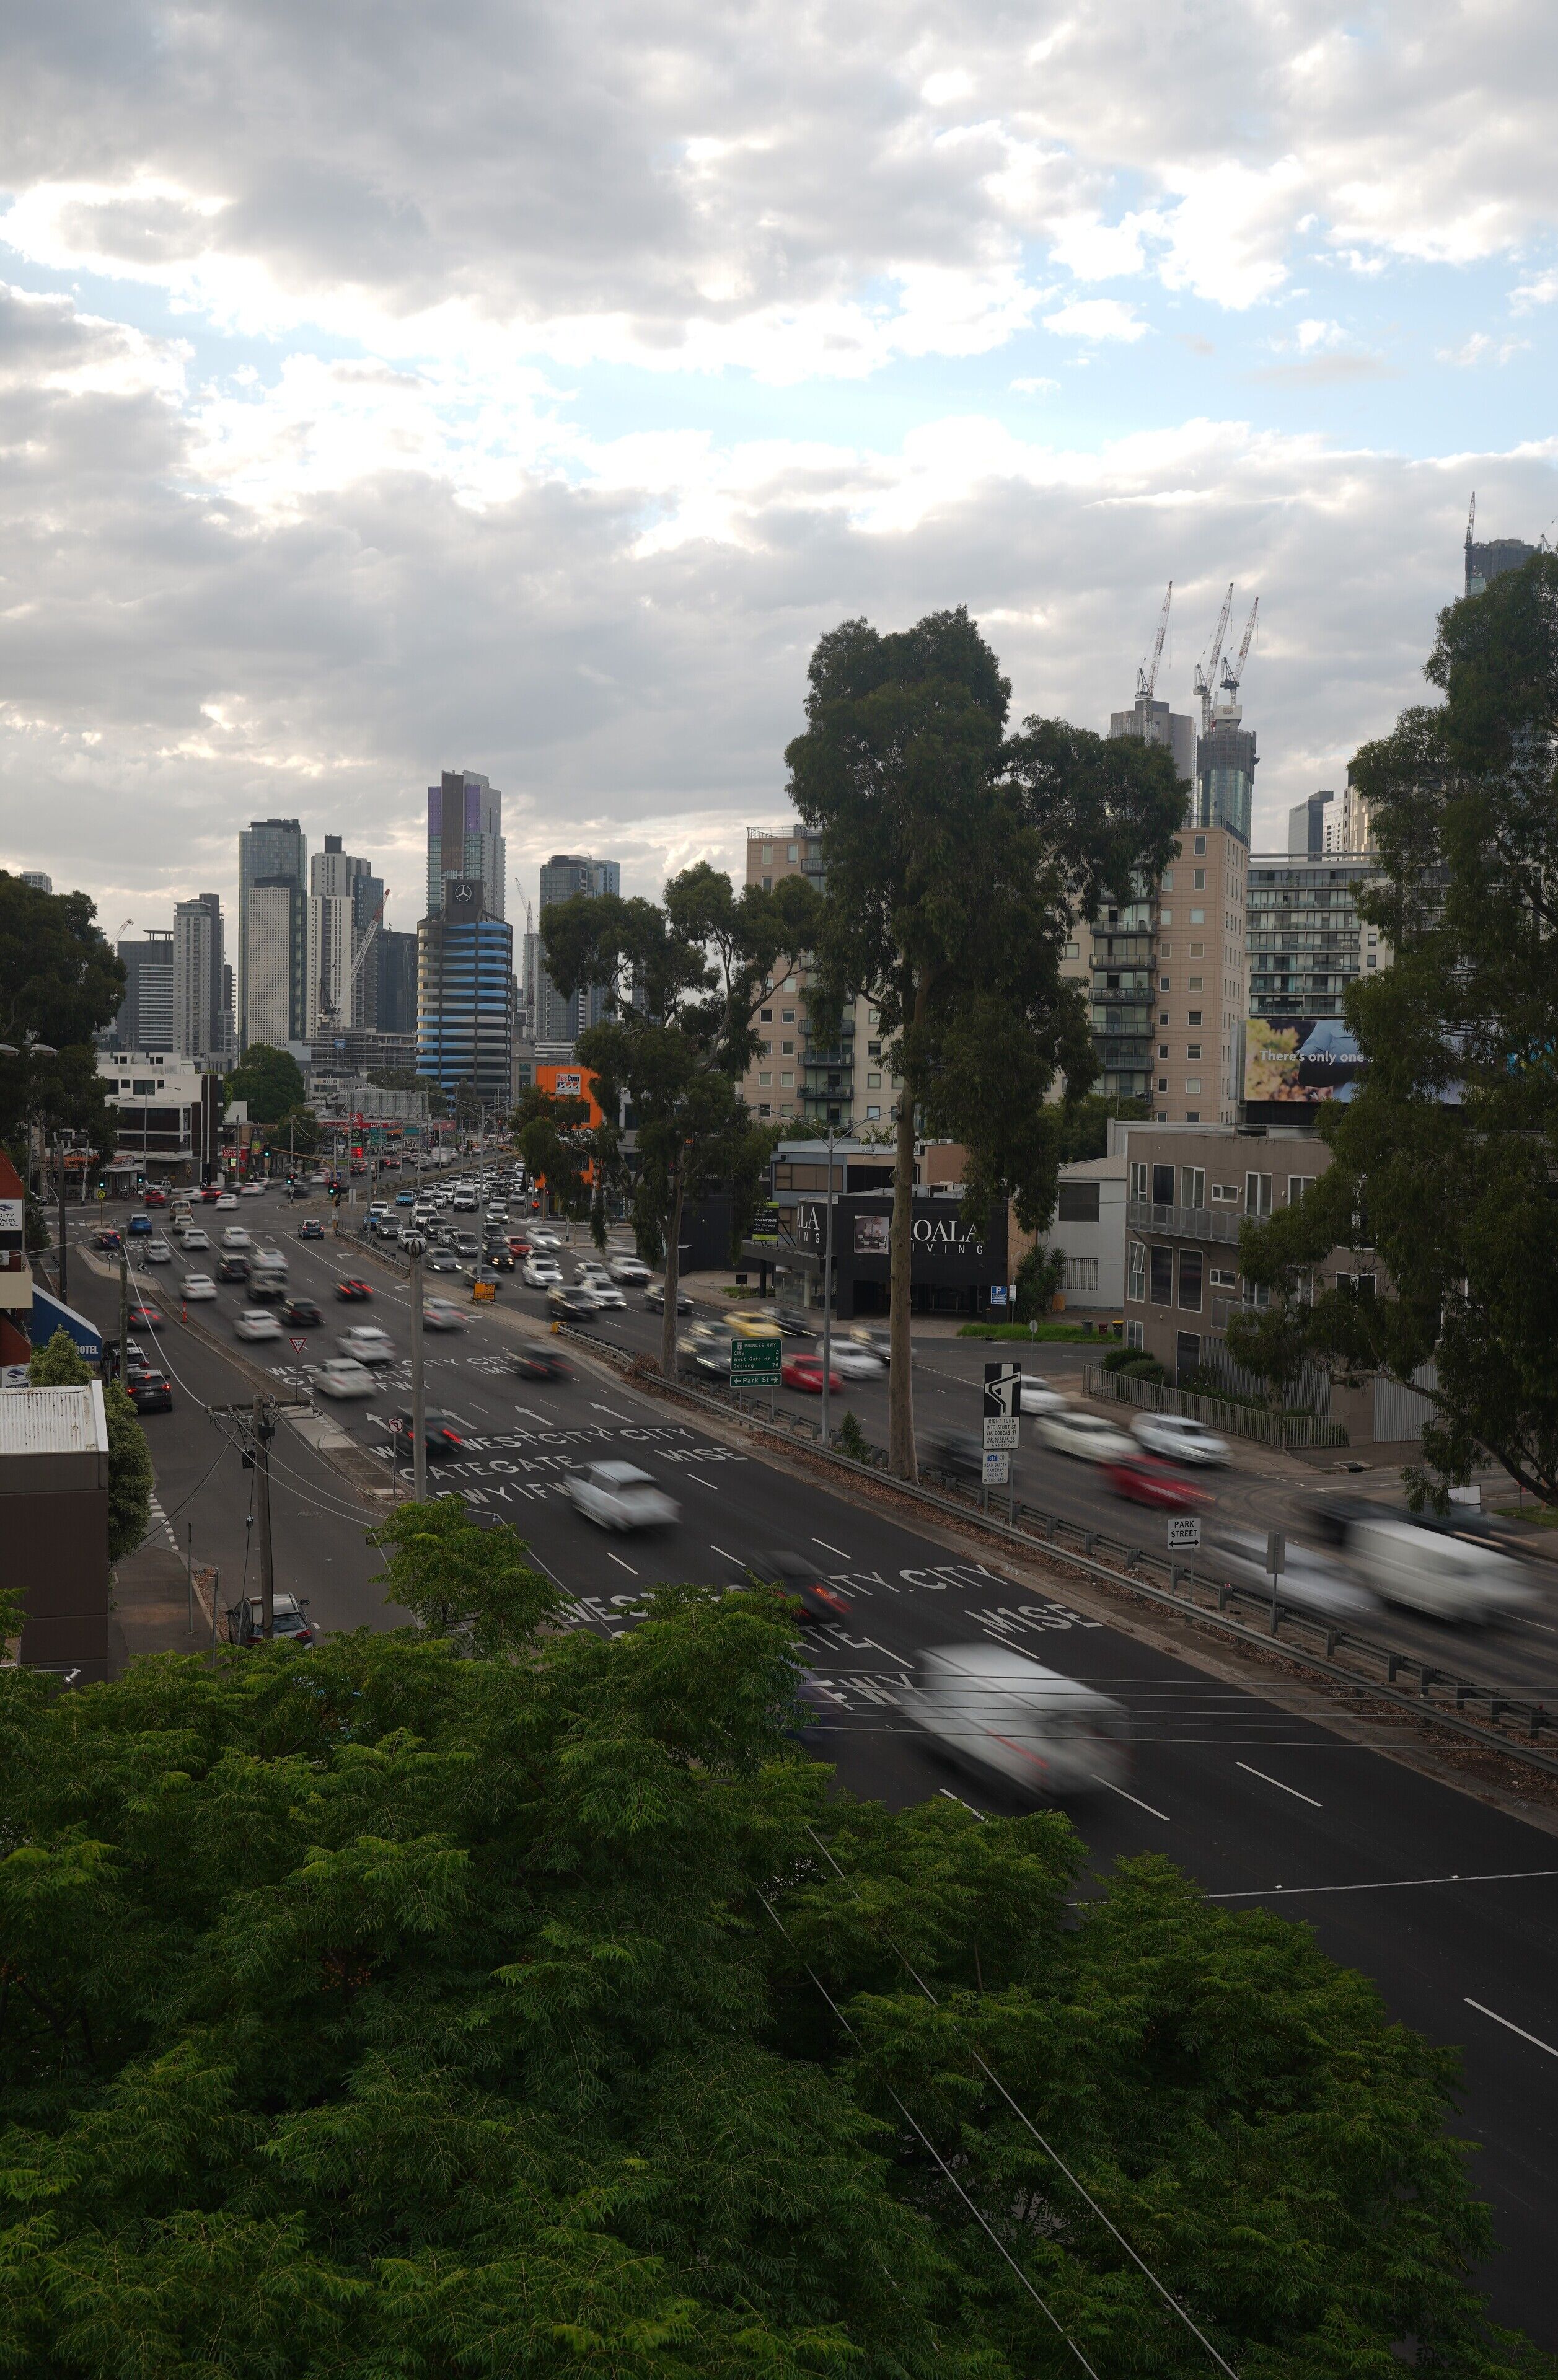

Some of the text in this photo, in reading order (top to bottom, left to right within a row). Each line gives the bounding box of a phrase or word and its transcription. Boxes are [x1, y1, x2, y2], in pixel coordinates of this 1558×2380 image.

[1260, 1049, 1305, 1062] There's
[1308, 1050, 1334, 1065] only
[1340, 1053, 1365, 1062] one
[912, 1243, 983, 1254] IVING
[620, 1427, 695, 1440] CITY
[488, 1455, 584, 1473] GATE
[1171, 1529, 1197, 1538] STREET
[899, 1564, 1010, 1590] CITY
